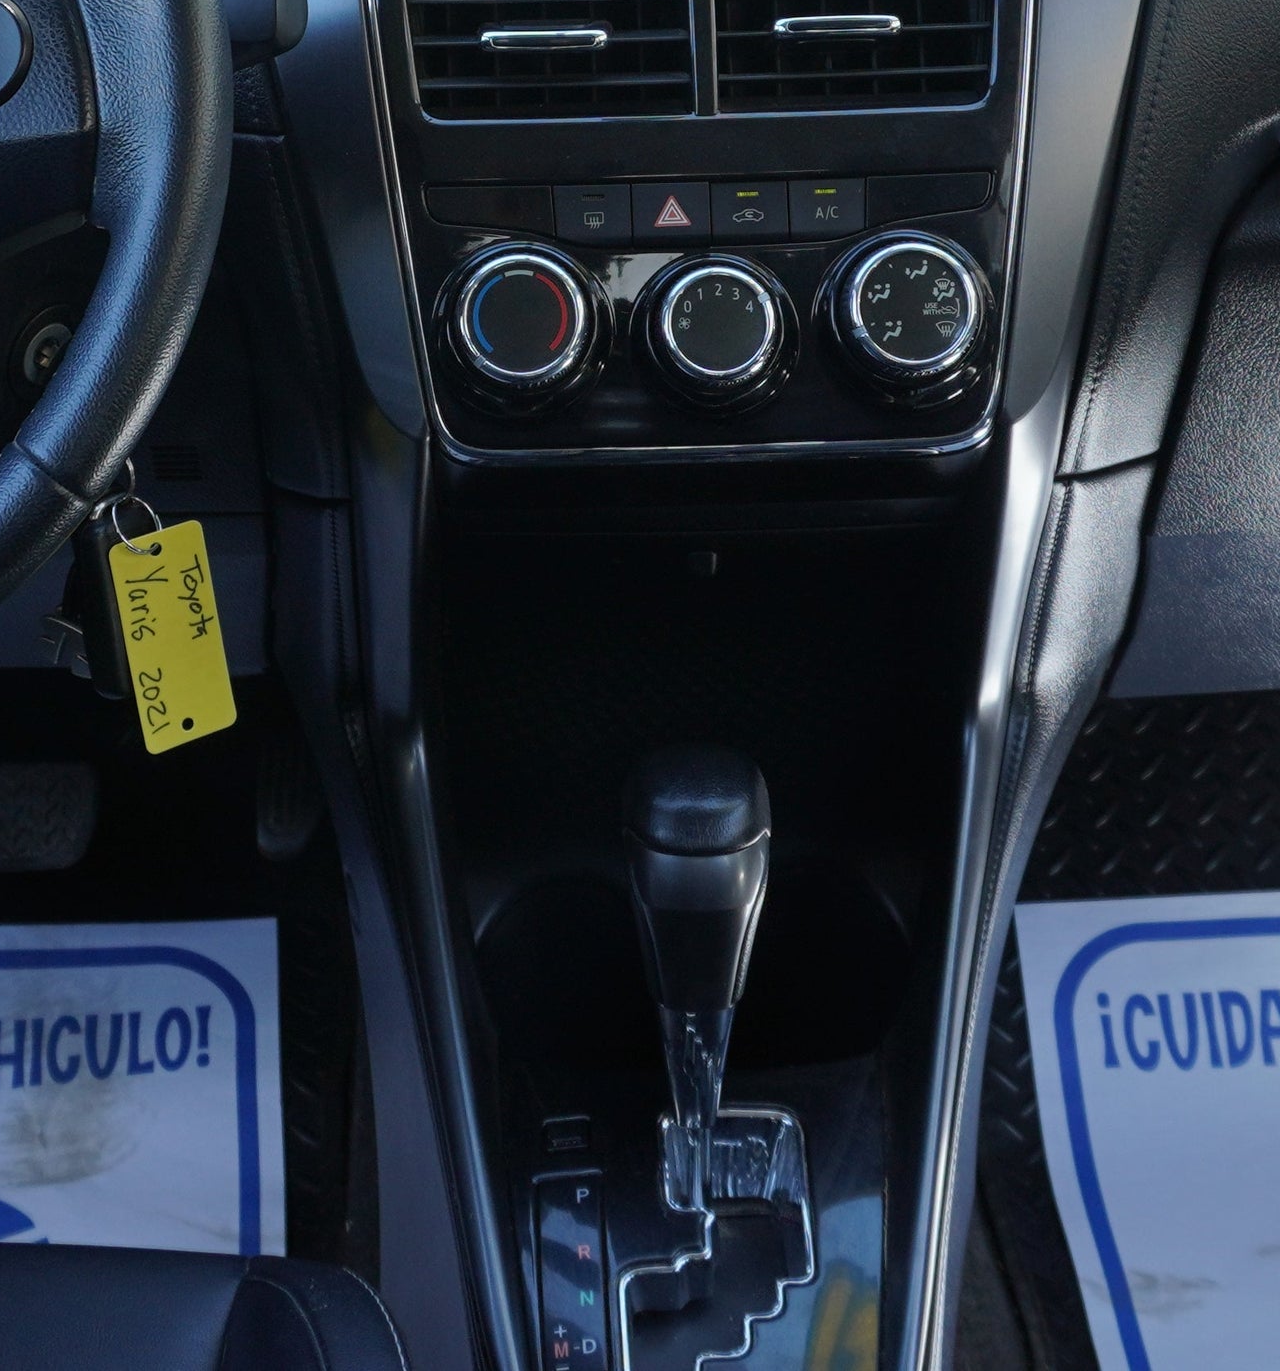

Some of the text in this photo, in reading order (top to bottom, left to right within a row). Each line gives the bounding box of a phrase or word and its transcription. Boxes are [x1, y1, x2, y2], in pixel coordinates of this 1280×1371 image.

[815, 205, 839, 220] A/C
[697, 287, 703, 301] 1
[714, 283, 722, 296] 2
[732, 287, 740, 300] 3
[683, 300, 692, 313] 0
[745, 300, 754, 313] 4
[922, 308, 940, 316] WITH
[177, 554, 214, 640] Toyota
[124, 565, 170, 734] Yaris 2021
[576, 1188, 590, 1204] P
[578, 1244, 591, 1260] R
[580, 1289, 595, 1307] N
[554, 1342, 569, 1359] M
